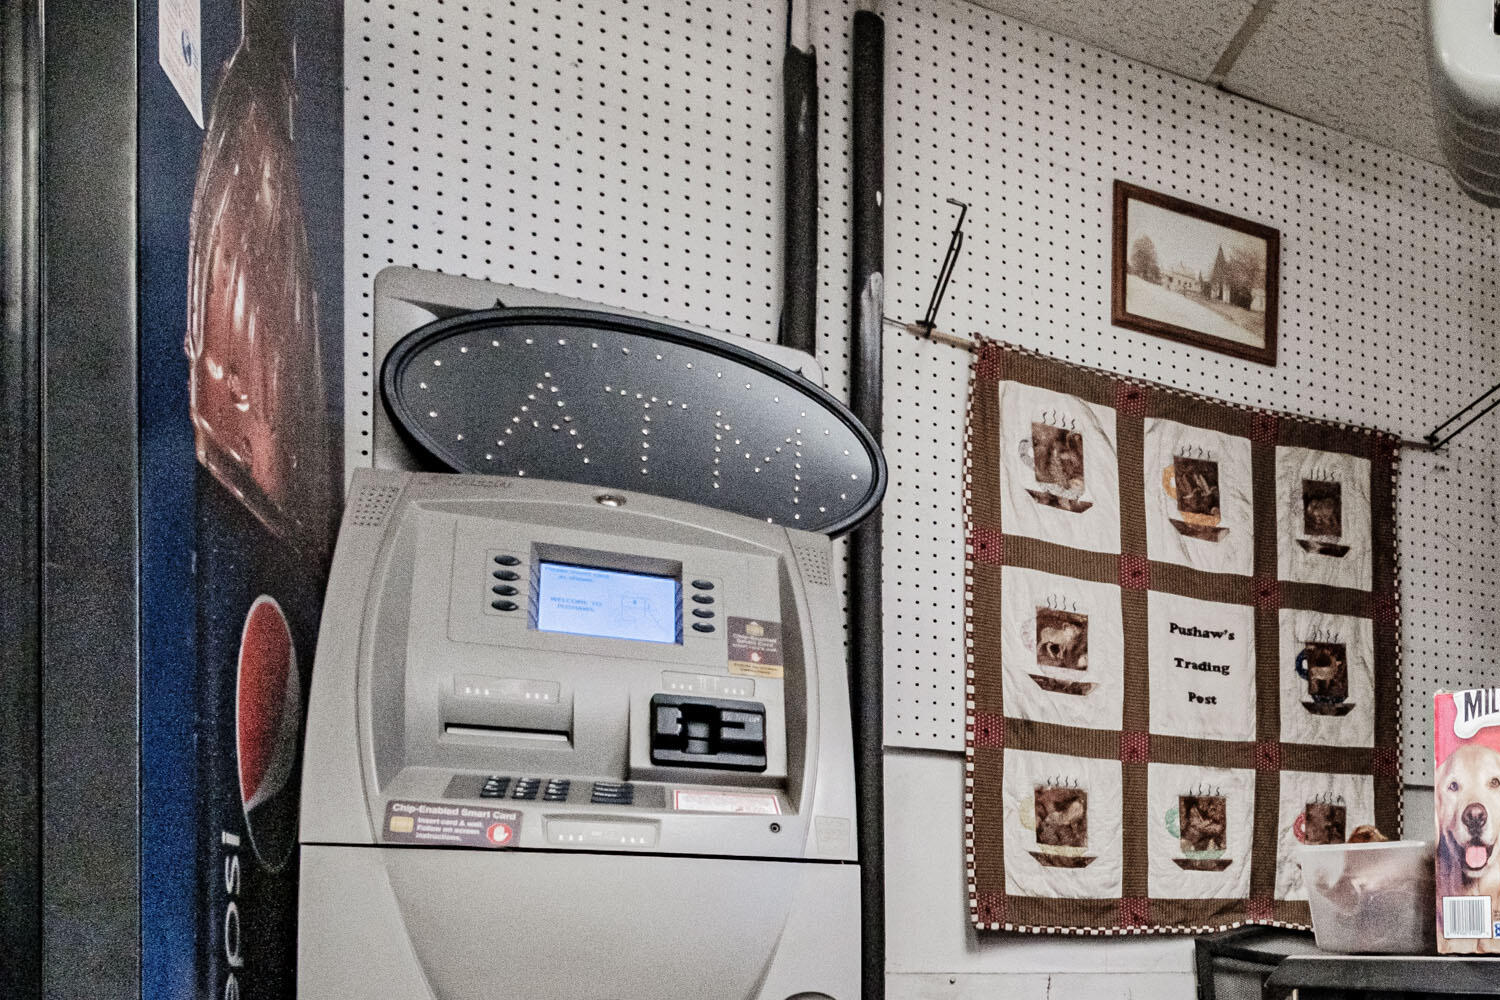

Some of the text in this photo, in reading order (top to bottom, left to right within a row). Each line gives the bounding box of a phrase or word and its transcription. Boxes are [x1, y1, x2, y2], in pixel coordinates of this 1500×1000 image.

[486, 371, 801, 503] ATM
[1169, 622, 1235, 641] Pushaw's
[1174, 657, 1230, 676] Trading
[1188, 691, 1217, 705] Post
[392, 803, 517, 820] Chip-Enabled Smart Card
